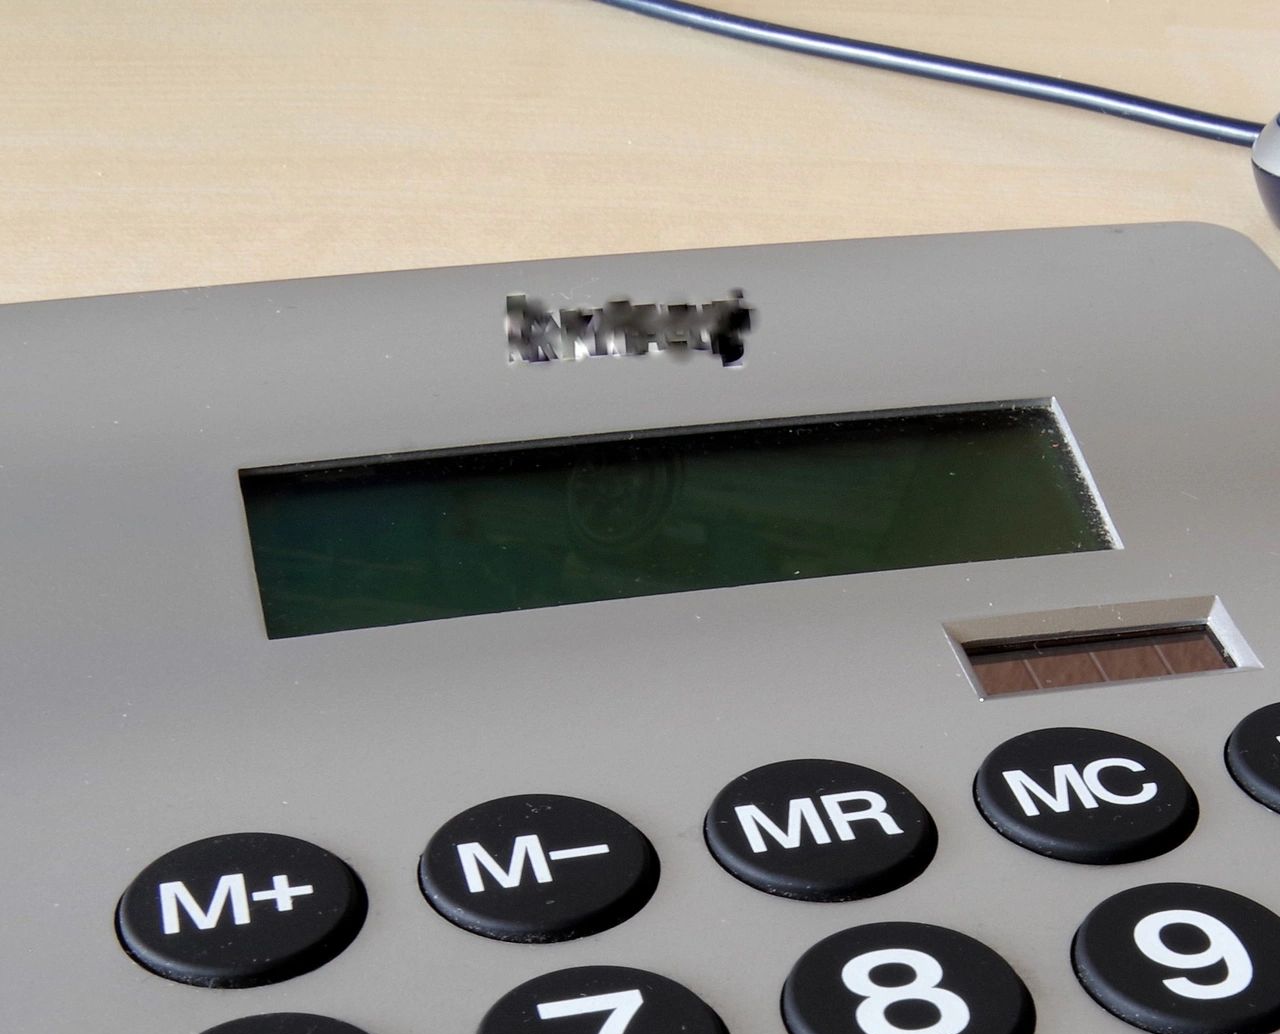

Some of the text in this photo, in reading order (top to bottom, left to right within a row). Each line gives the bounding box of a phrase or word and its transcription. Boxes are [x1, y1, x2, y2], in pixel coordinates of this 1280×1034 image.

[1003, 758, 1157, 816] MC
[735, 791, 904, 852] MR
[159, 874, 313, 934] M+
[1134, 910, 1253, 999] 9
